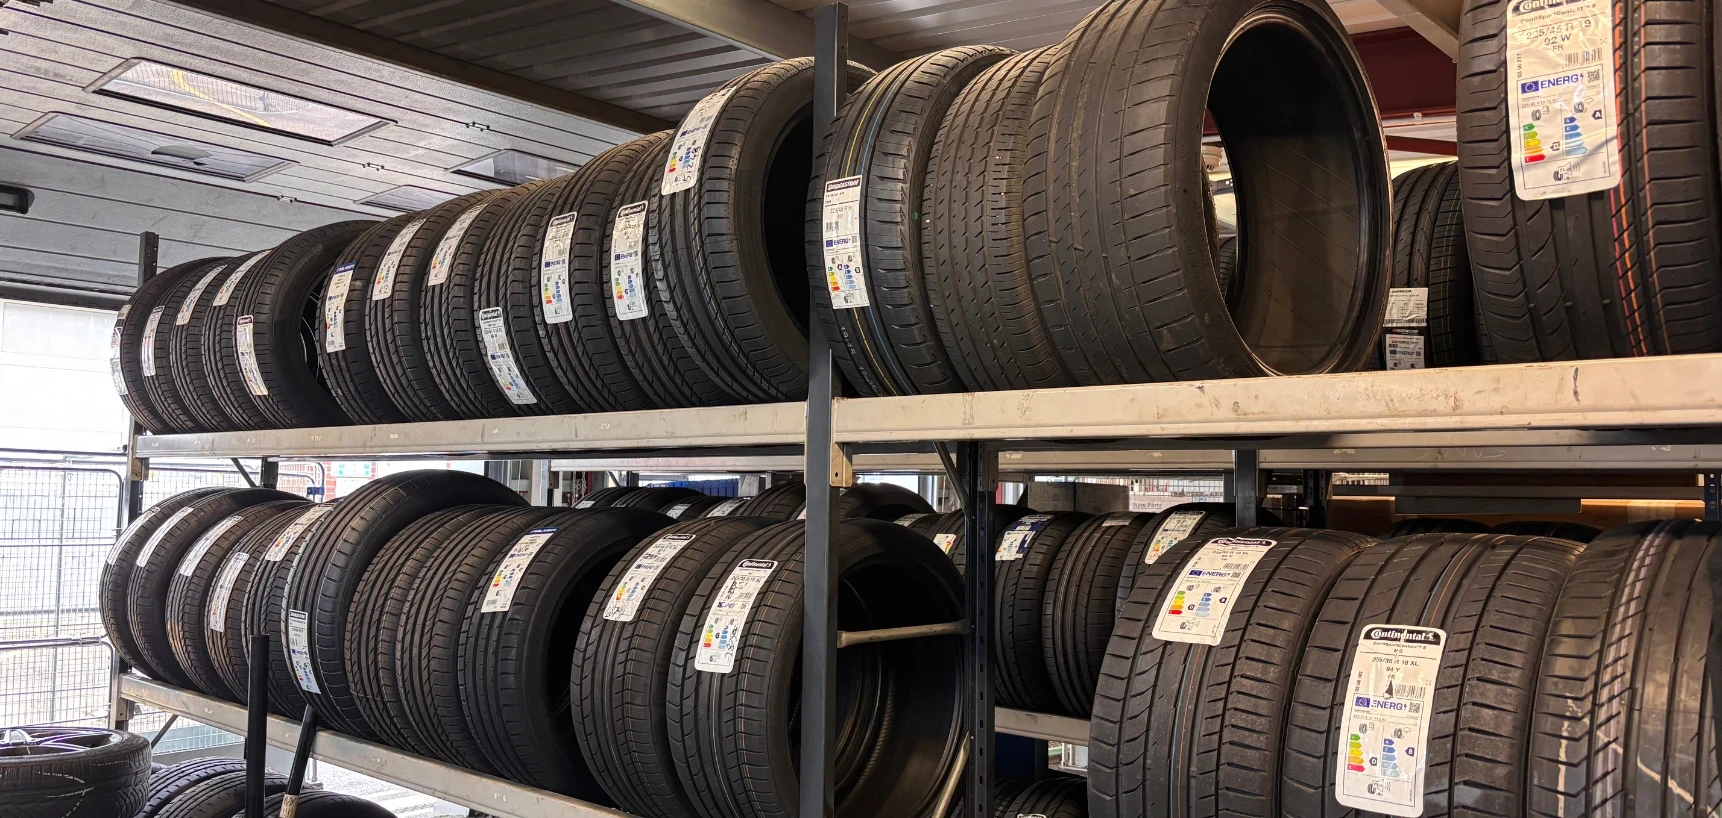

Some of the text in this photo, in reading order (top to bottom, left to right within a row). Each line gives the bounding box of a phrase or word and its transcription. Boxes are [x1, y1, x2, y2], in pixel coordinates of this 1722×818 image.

[1544, 33, 1571, 46] 92 W
[1552, 44, 1564, 52] FR
[1541, 73, 1579, 89] ENERG
[1371, 699, 1403, 711] ENERG
